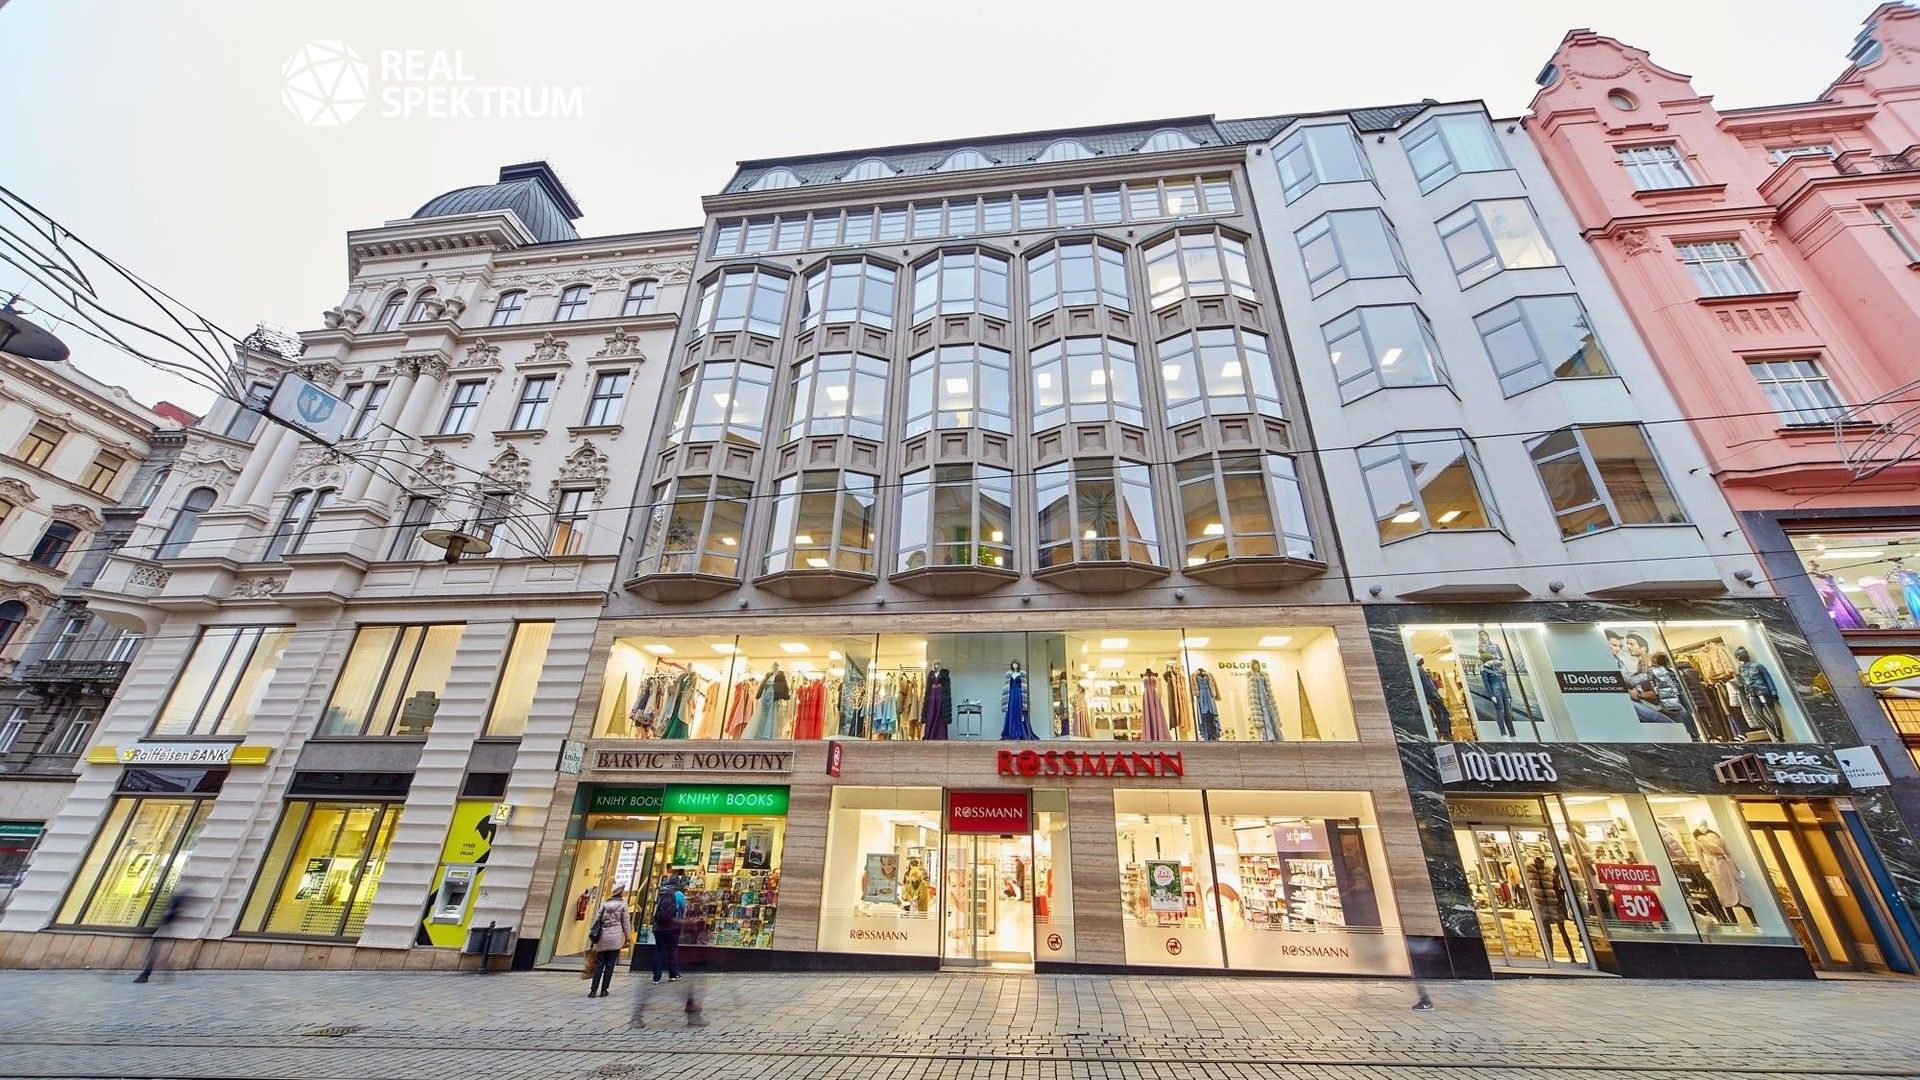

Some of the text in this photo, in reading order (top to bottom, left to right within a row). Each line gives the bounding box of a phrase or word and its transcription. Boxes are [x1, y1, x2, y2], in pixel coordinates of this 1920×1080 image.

[1873, 665, 1920, 680] Panos
[134, 749, 228, 761] Raiffeisen BANK
[1765, 751, 1822, 765] Palác
[998, 750, 1184, 777] ROSSMANN
[1773, 771, 1839, 784] Petrov
[596, 796, 627, 806] KNIHY
[678, 793, 774, 806] KNIHY BOOKS
[955, 805, 1023, 818] ROSSMANN
[1601, 866, 1656, 882] VÝPRODEJ
[1620, 894, 1656, 917] -50%
[850, 929, 908, 941] ROSSMANN
[1281, 945, 1349, 958] ROSSMANN
